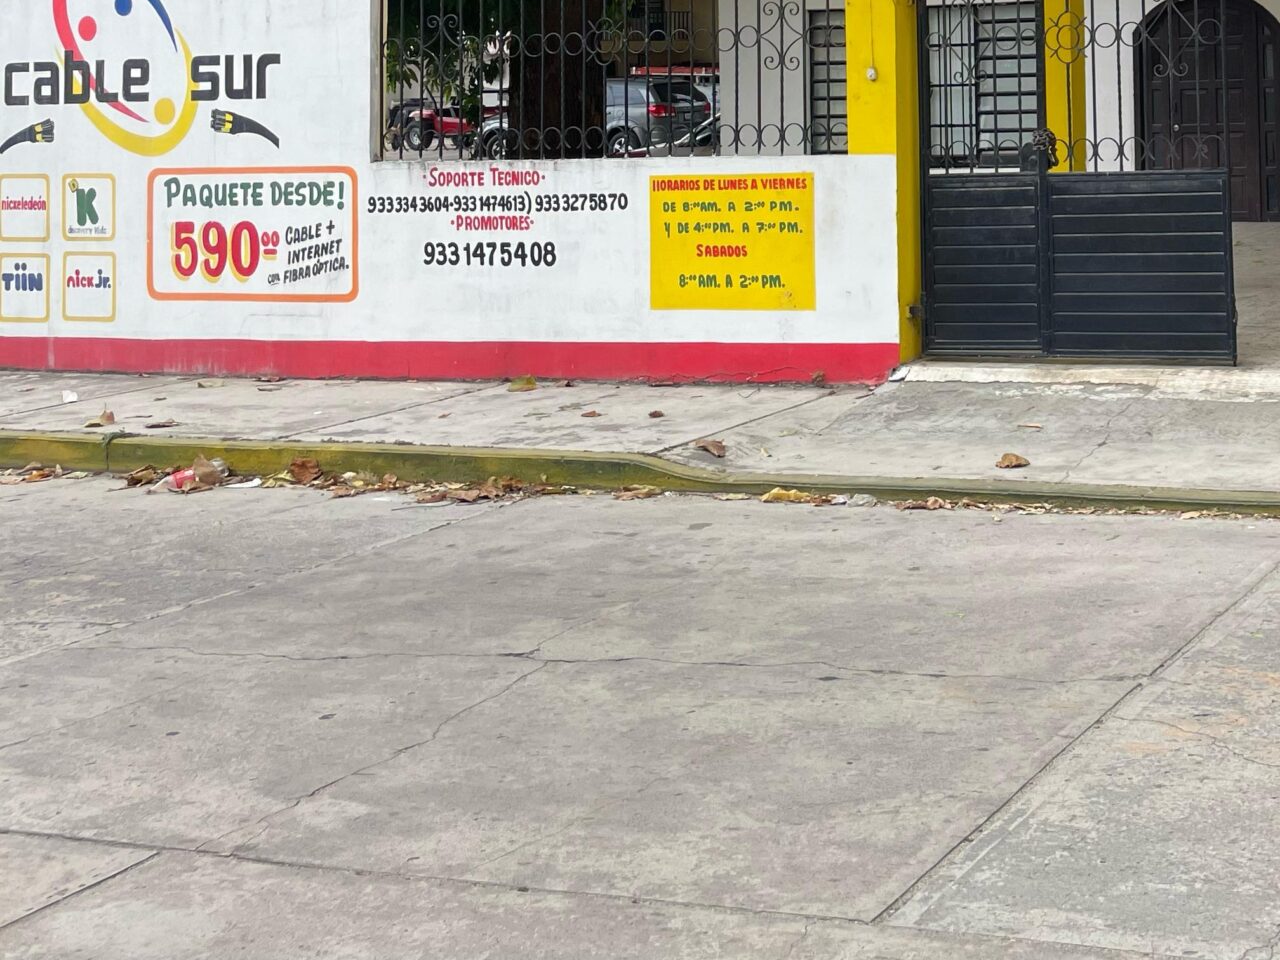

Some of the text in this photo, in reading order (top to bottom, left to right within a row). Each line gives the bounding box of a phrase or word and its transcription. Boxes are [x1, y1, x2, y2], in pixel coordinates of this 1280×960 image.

[4, 50, 281, 106] cable sur
[428, 166, 540, 187] SOPORTE TECNICO
[703, 179, 715, 190] DE
[718, 178, 748, 190] LUNES
[750, 179, 758, 190] A
[761, 178, 807, 190] VIERNES
[164, 177, 344, 210] PAQUETE DESDE!
[663, 202, 676, 212] DE
[727, 202, 736, 212] A
[456, 214, 530, 231] PROMOTORES
[677, 222, 689, 234] DE
[742, 222, 749, 233] A
[285, 223, 322, 246] CABLE
[287, 238, 343, 266] INTERNET
[696, 244, 747, 257] SABADOS
[284, 265, 311, 284] FIBRA
[725, 274, 733, 288] A
